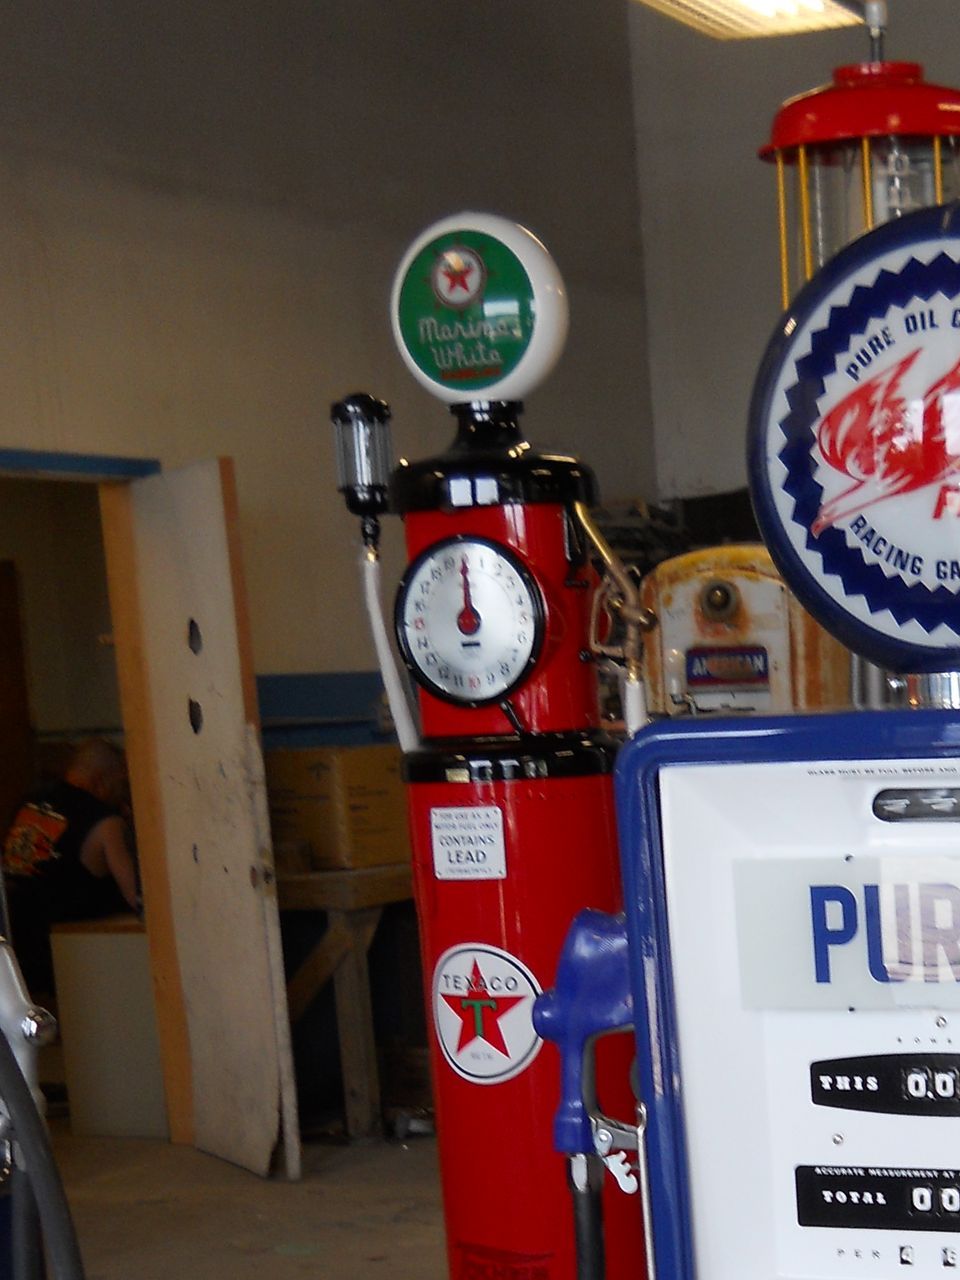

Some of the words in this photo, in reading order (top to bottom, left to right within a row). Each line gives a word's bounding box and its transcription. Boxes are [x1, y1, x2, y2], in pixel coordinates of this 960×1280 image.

[845, 326, 895, 381] PURE
[904, 308, 939, 334] OIL
[849, 514, 924, 577] RACING
[447, 849, 487, 865] LEAD
[443, 974, 518, 992] TEXACO
[461, 999, 497, 1036] T
[819, 1074, 879, 1093] THIS
[815, 1166, 866, 1177] ACCURATE
[822, 1190, 887, 1205] TOTAL
